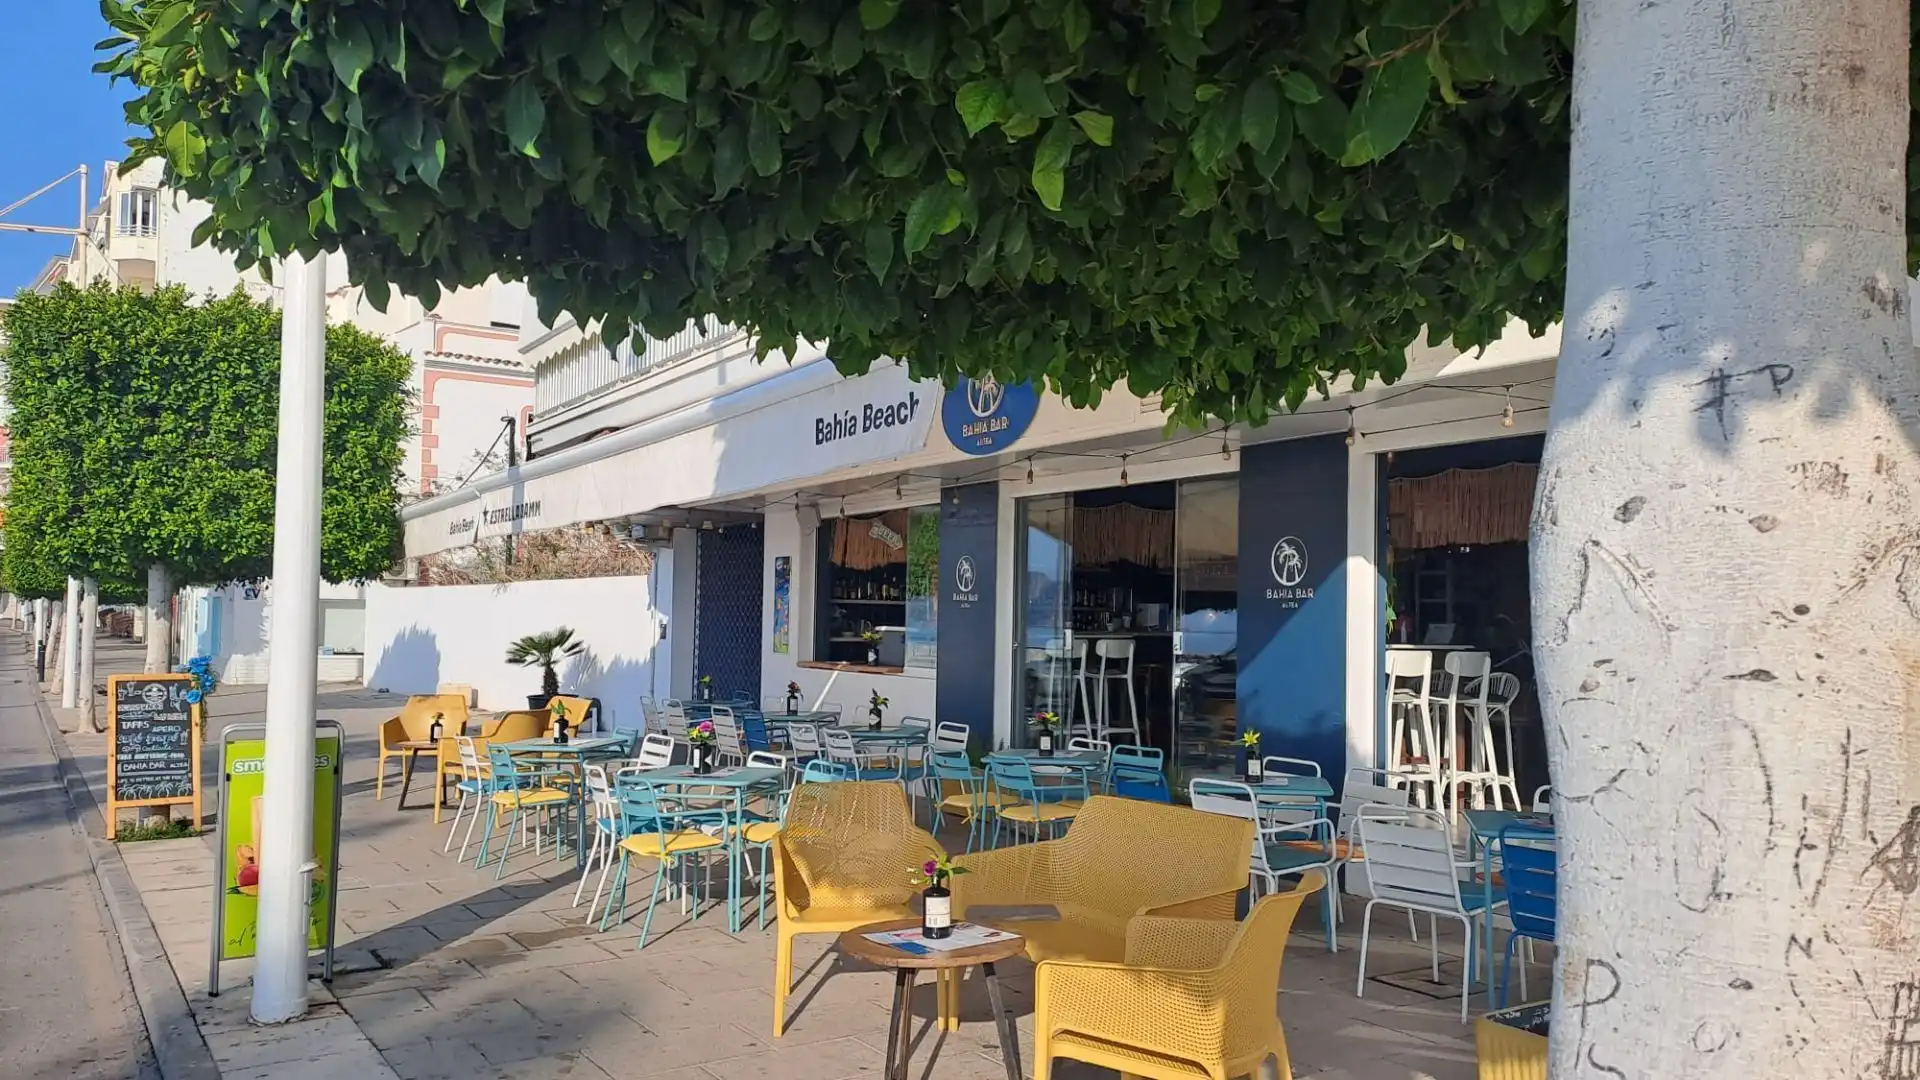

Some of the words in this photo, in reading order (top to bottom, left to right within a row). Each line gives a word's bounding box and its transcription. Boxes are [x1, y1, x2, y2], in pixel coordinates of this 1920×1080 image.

[815, 409, 858, 445] Bahía
[962, 421, 988, 438] BAHIA
[990, 416, 1009, 432] BAR
[1266, 588, 1294, 599] BAHIA
[1295, 587, 1314, 599] BAR
[123, 762, 147, 771] BAHIA
[148, 761, 167, 770] BAR
